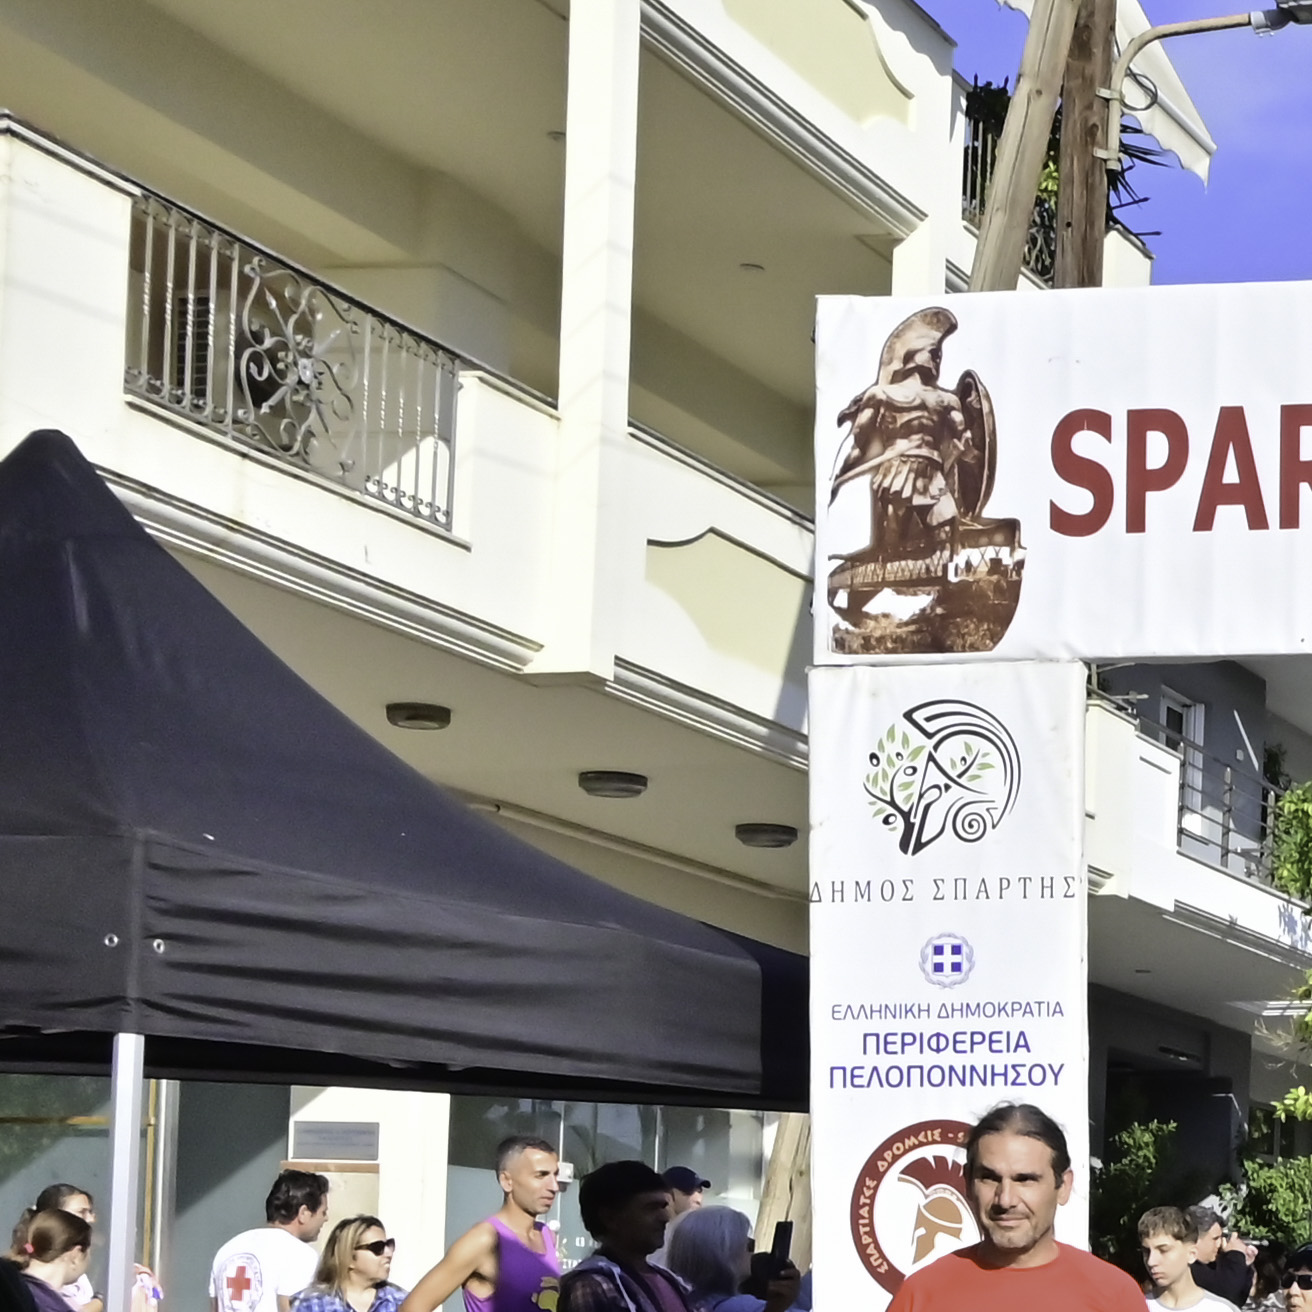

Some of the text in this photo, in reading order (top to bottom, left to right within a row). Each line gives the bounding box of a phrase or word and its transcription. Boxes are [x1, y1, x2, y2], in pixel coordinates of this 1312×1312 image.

[810, 876, 1076, 904] ΔΗΜΟΣ ΣΠΑΡΤΗΣ
[831, 1000, 1064, 1020] ΕΛΛΗΝΙΚΗ ΔΗΜΟΚΡΑΤΙΑ
[862, 1030, 1032, 1056] ΠΕΡΙΦΕΡΕΙΑ
[829, 1063, 1065, 1089] ΠΕΛΟΠΟΝΝΗΣΟΥ
